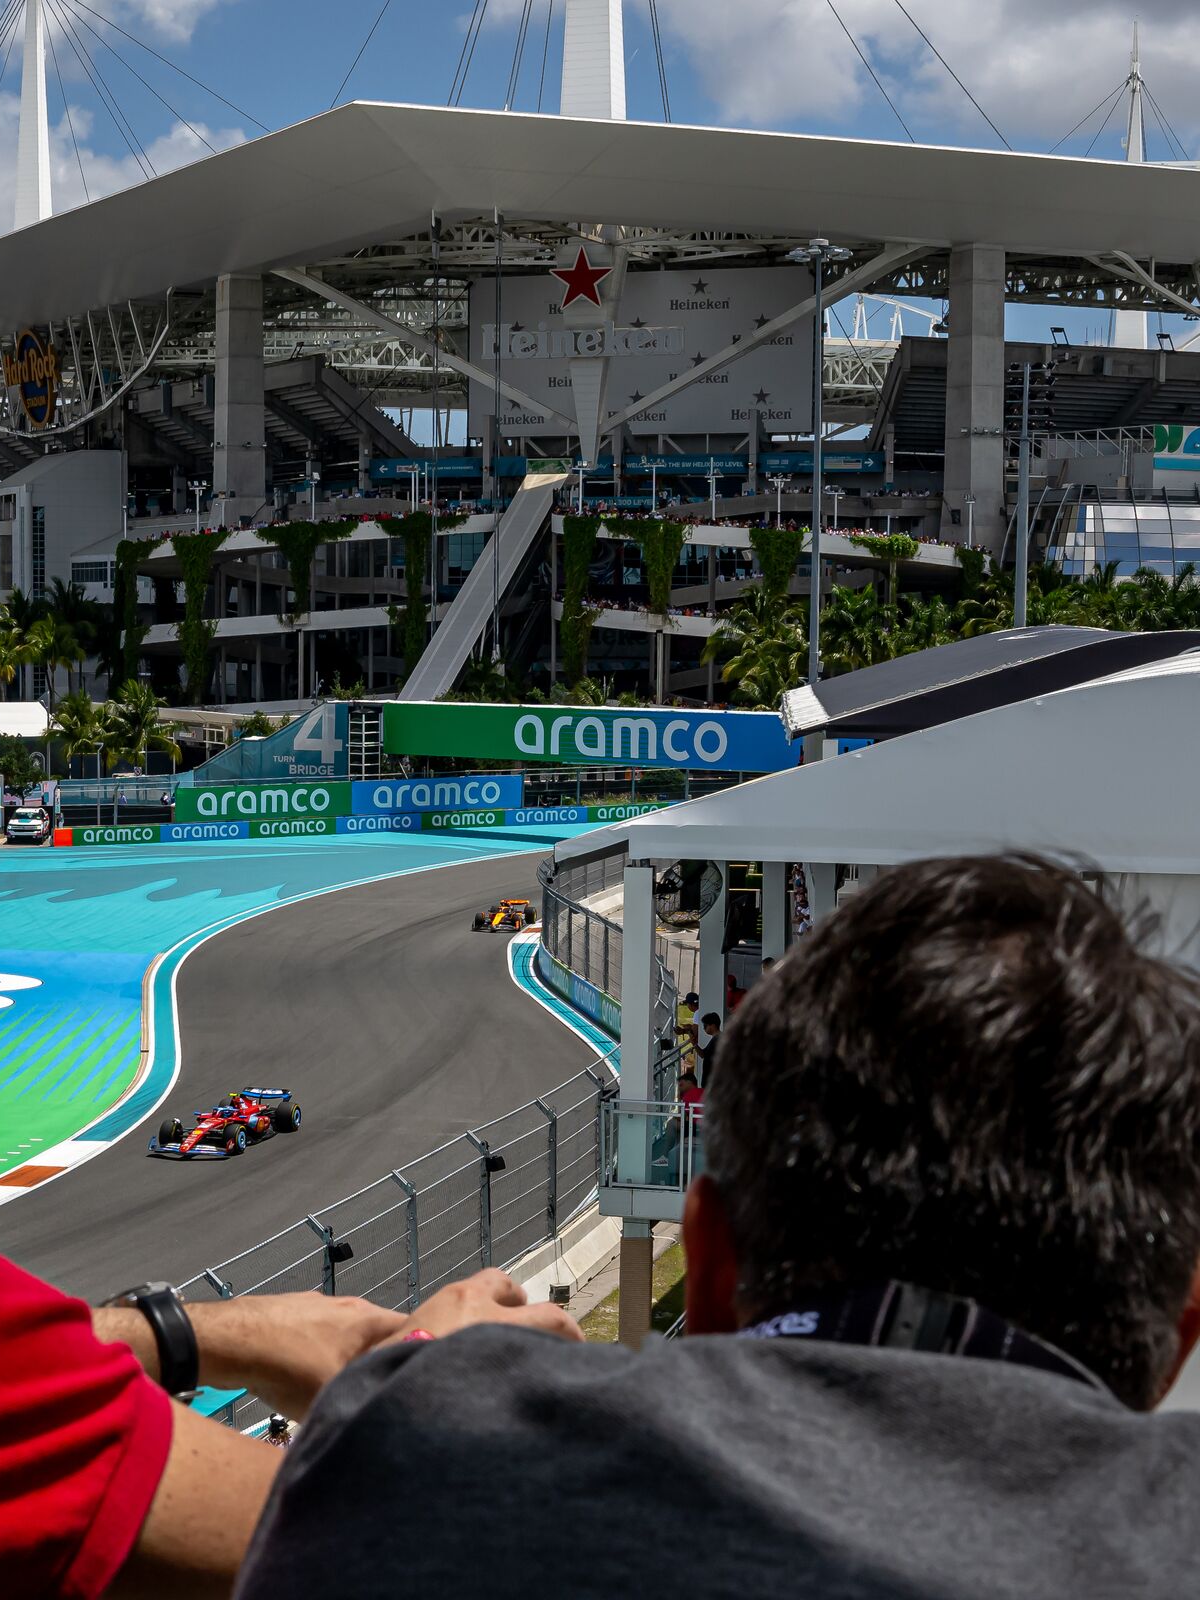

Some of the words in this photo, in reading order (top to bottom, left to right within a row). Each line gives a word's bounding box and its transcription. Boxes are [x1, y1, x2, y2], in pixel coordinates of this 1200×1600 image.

[669, 299, 729, 311] Heineken
[3, 350, 29, 388] Hard
[29, 343, 58, 391] Rock
[498, 414, 546, 426] eineken
[731, 409, 792, 421] Heieken
[273, 755, 296, 763] TURN
[293, 703, 343, 764] 4
[514, 714, 728, 763] aramco
[289, 764, 335, 776] BRIDGE
[197, 788, 330, 815] aramco
[373, 781, 501, 808] aramco
[346, 815, 412, 831] aramco
[432, 812, 495, 826] aramco
[516, 809, 578, 823] aramco
[83, 827, 153, 843] aramco
[171, 824, 239, 839] aramco
[260, 820, 327, 835] aramco
[574, 980, 597, 1014] aramco
